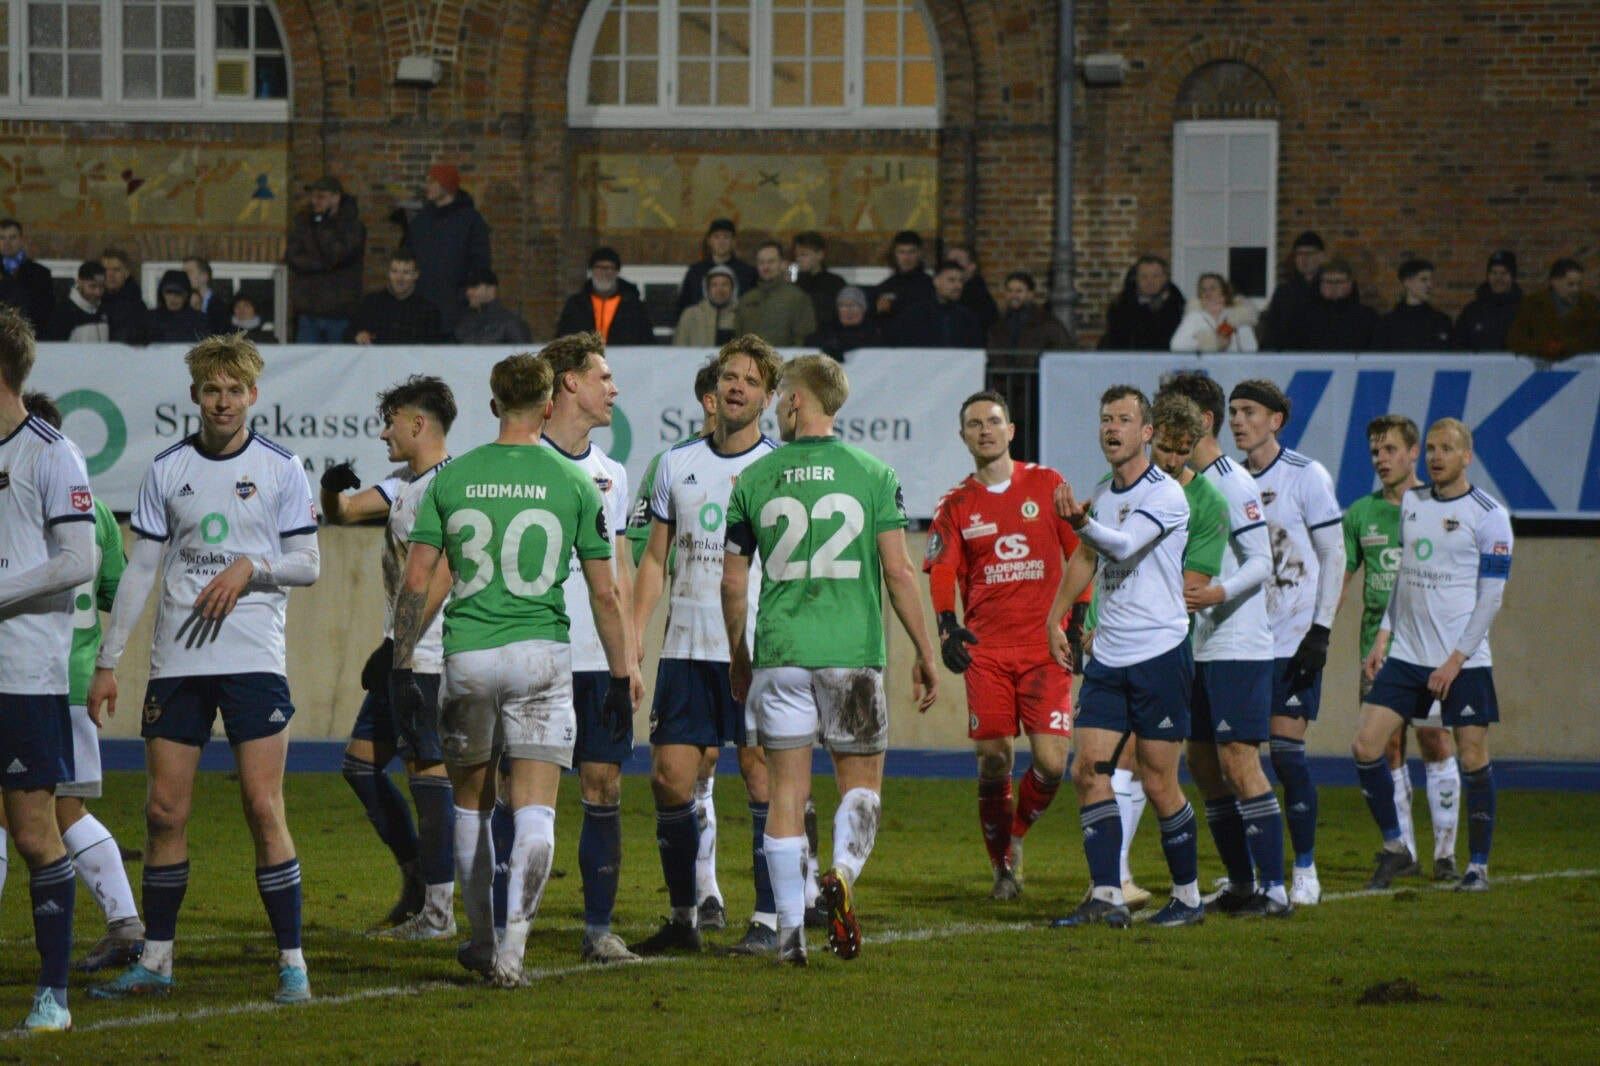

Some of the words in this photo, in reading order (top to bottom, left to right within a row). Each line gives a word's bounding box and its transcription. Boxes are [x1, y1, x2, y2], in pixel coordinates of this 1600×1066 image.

[784, 466, 835, 484] TRIER
[465, 484, 547, 500] GUDMANN
[760, 493, 864, 581] 22
[446, 508, 563, 600] 30
[984, 560, 1045, 575] OLDENBORG
[985, 571, 1044, 584] STILLADSER
[1049, 710, 1071, 731] 25
